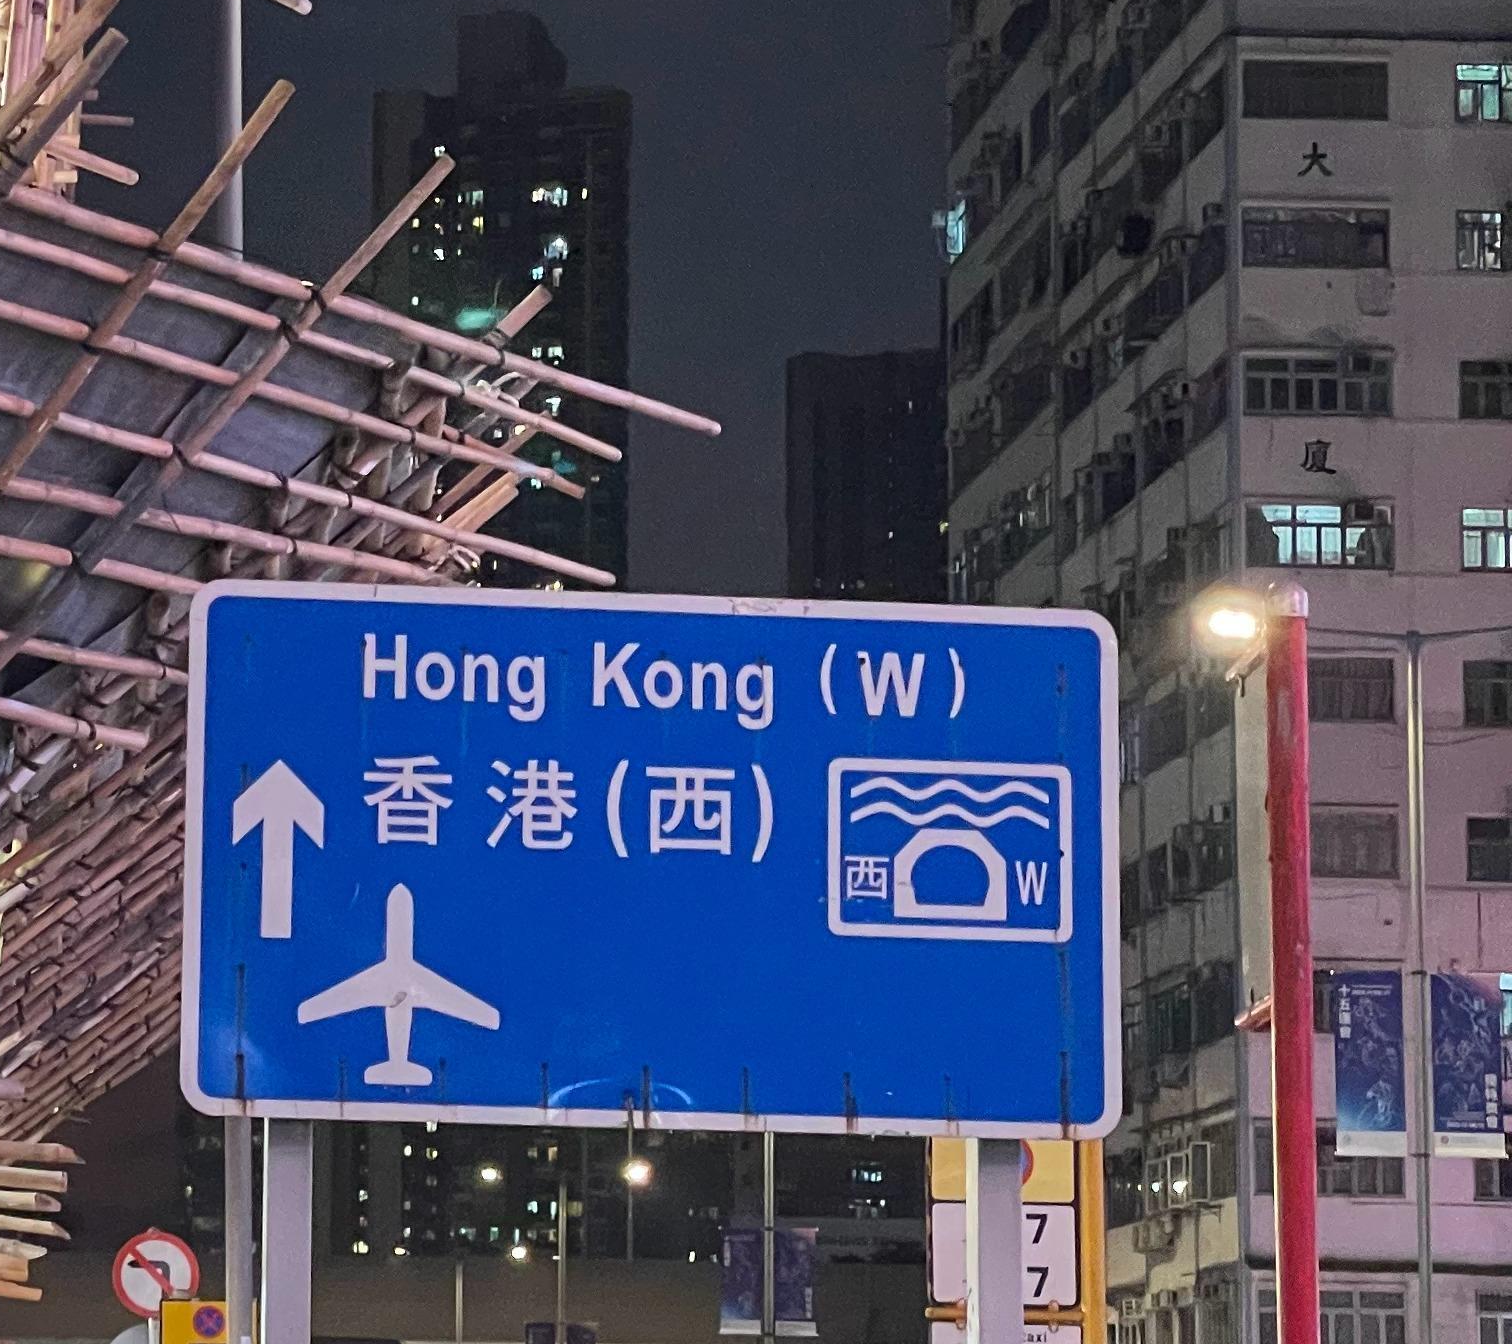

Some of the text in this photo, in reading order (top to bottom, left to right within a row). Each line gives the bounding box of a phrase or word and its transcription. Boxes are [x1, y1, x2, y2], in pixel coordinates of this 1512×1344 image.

[363, 633, 967, 731] Hong Kong (W)
[362, 755, 774, 863] 香港(西)
[845, 856, 890, 901] 西
[1015, 860, 1048, 906] W
[1026, 1213, 1048, 1245] 7
[1027, 1266, 1049, 1298] 7
